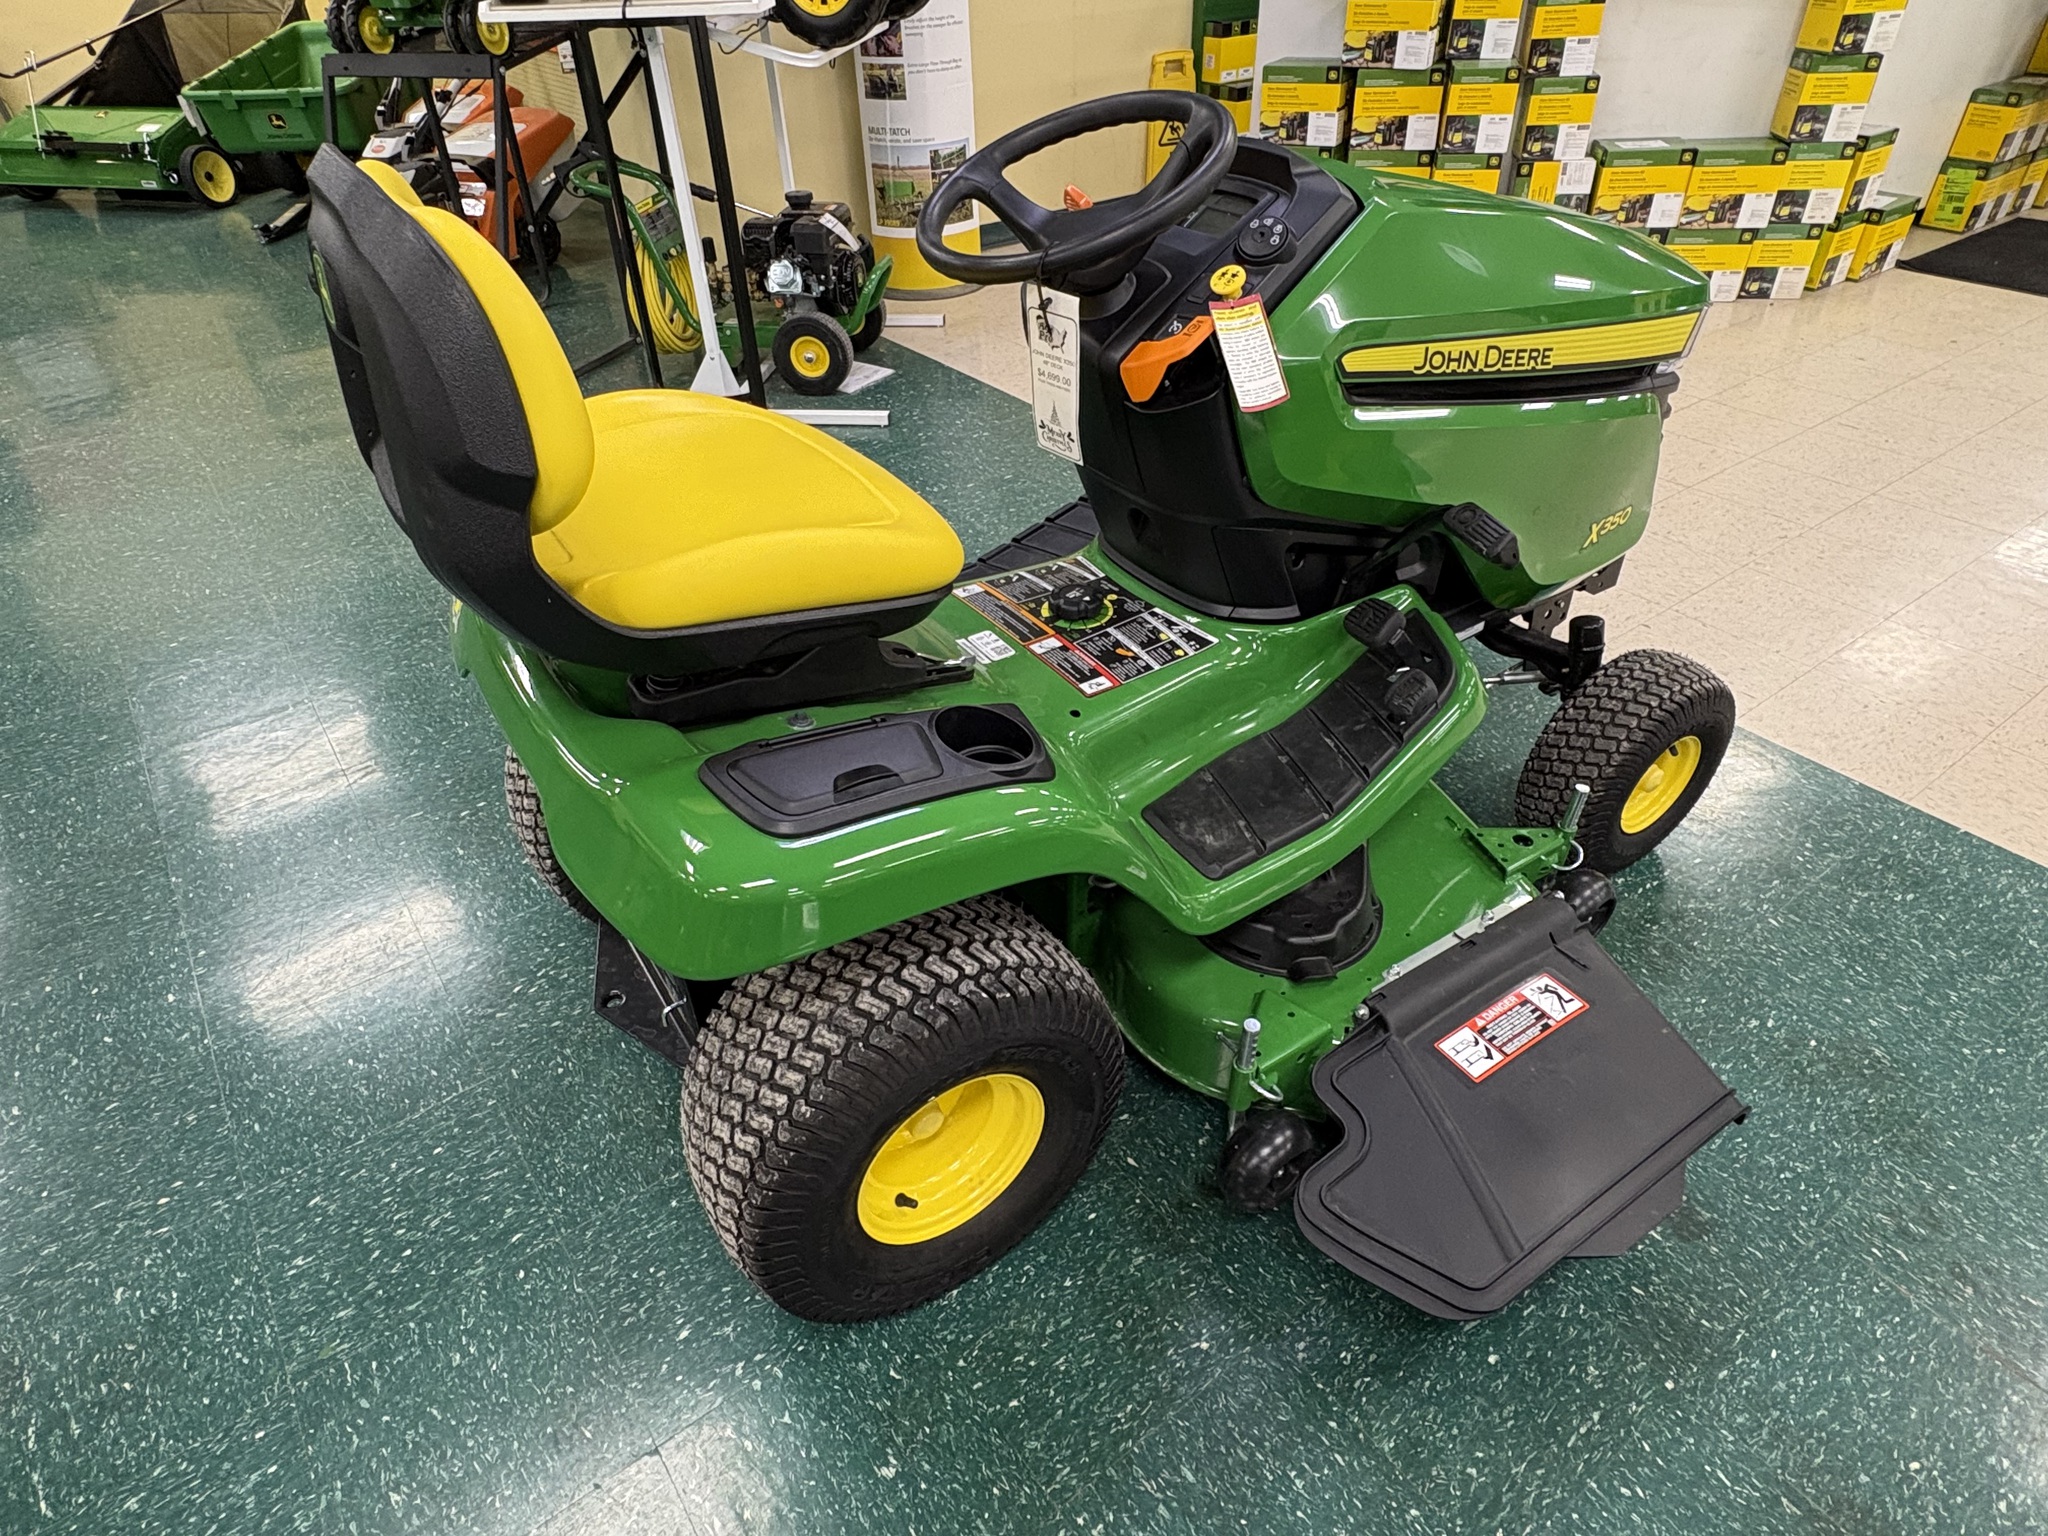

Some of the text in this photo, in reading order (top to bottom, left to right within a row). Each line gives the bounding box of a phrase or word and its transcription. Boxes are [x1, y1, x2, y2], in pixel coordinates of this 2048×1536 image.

[1413, 345, 1554, 373] JOHN DEERE
[1581, 505, 1633, 549] X350
[1481, 995, 1519, 1019] DANGER
